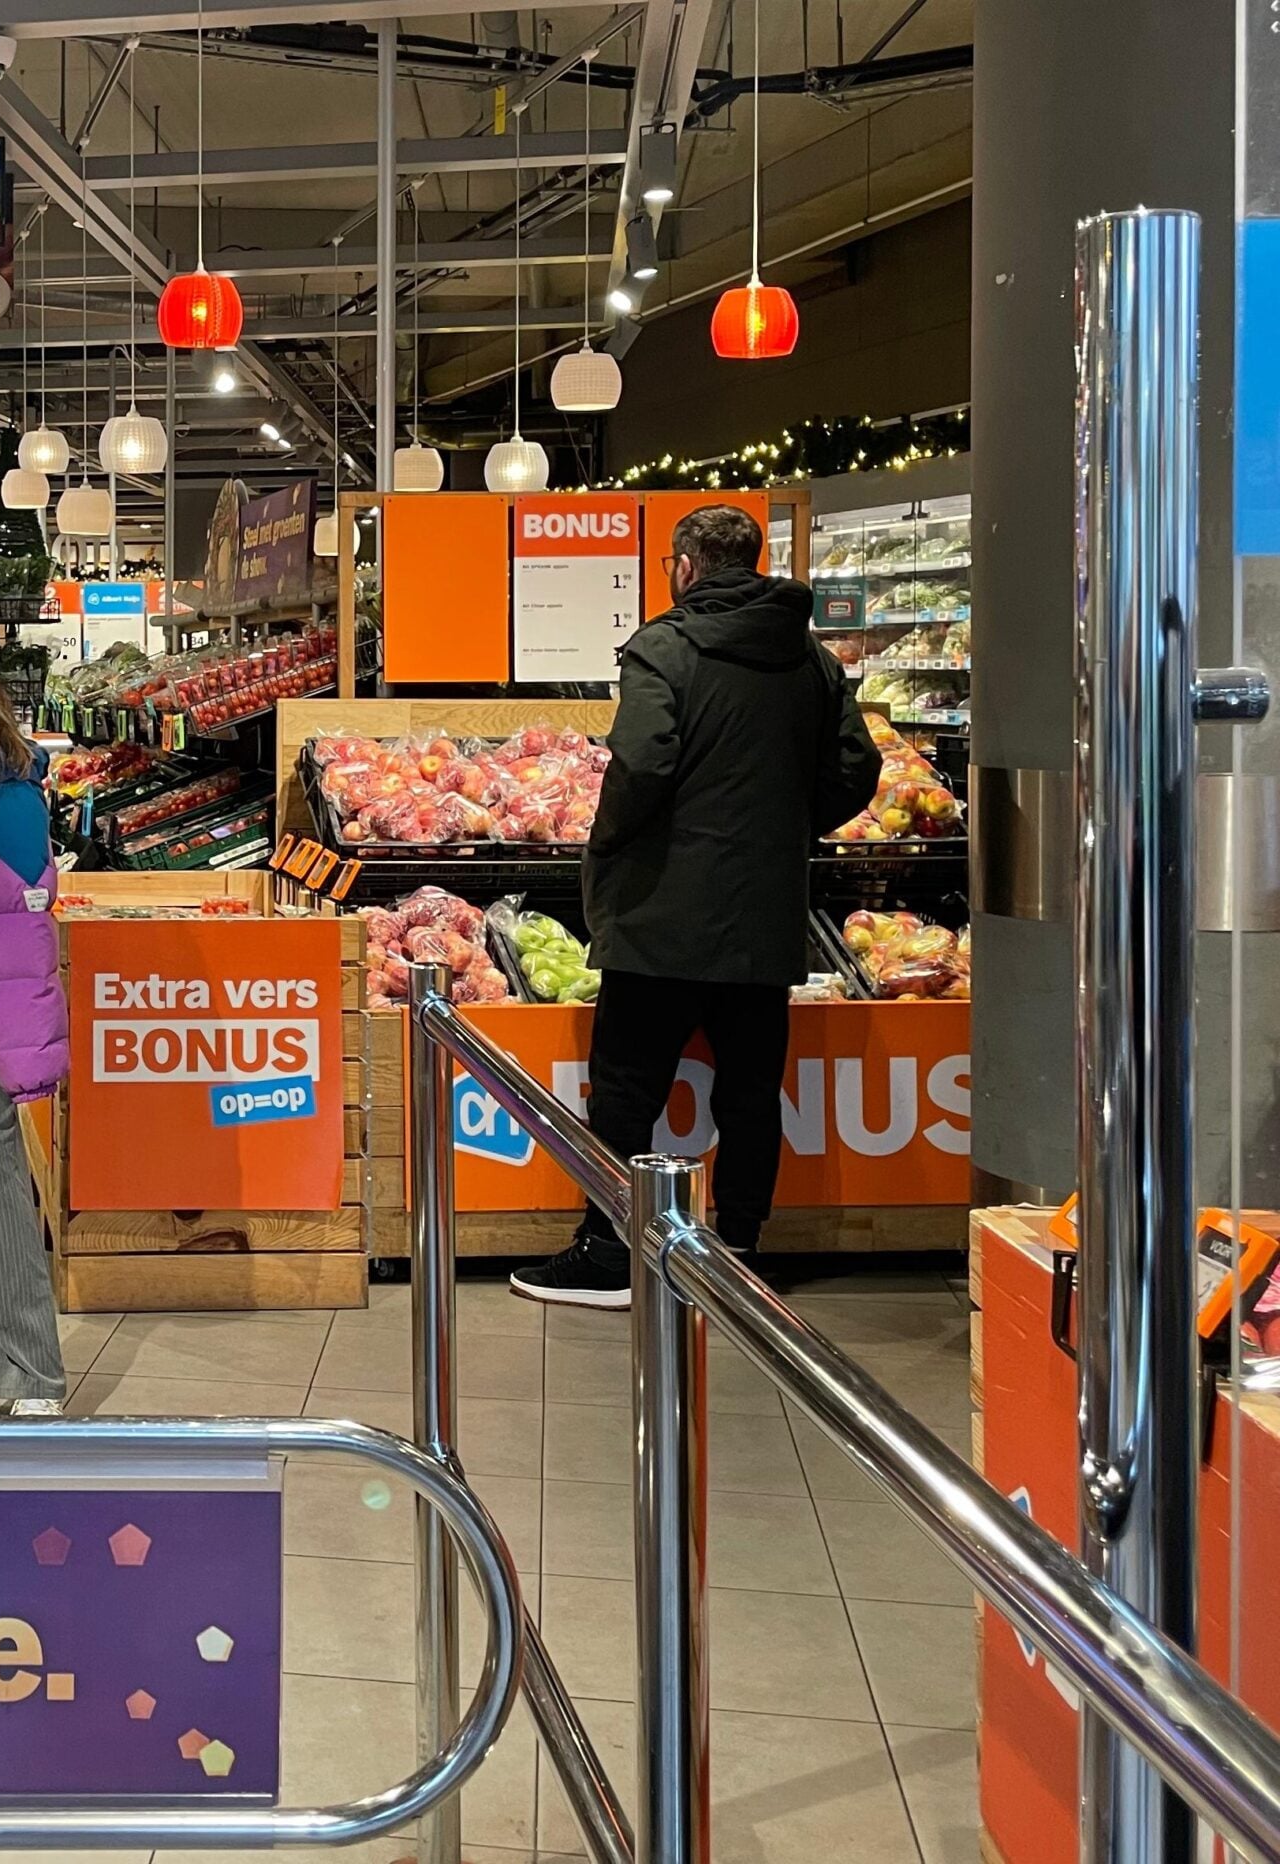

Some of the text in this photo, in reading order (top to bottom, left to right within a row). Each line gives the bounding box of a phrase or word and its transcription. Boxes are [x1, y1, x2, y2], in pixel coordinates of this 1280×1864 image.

[523, 513, 631, 539] BONUS
[93, 972, 319, 1010] Extra vers
[103, 1027, 309, 1074] BONUS
[220, 1086, 307, 1118] op=op
